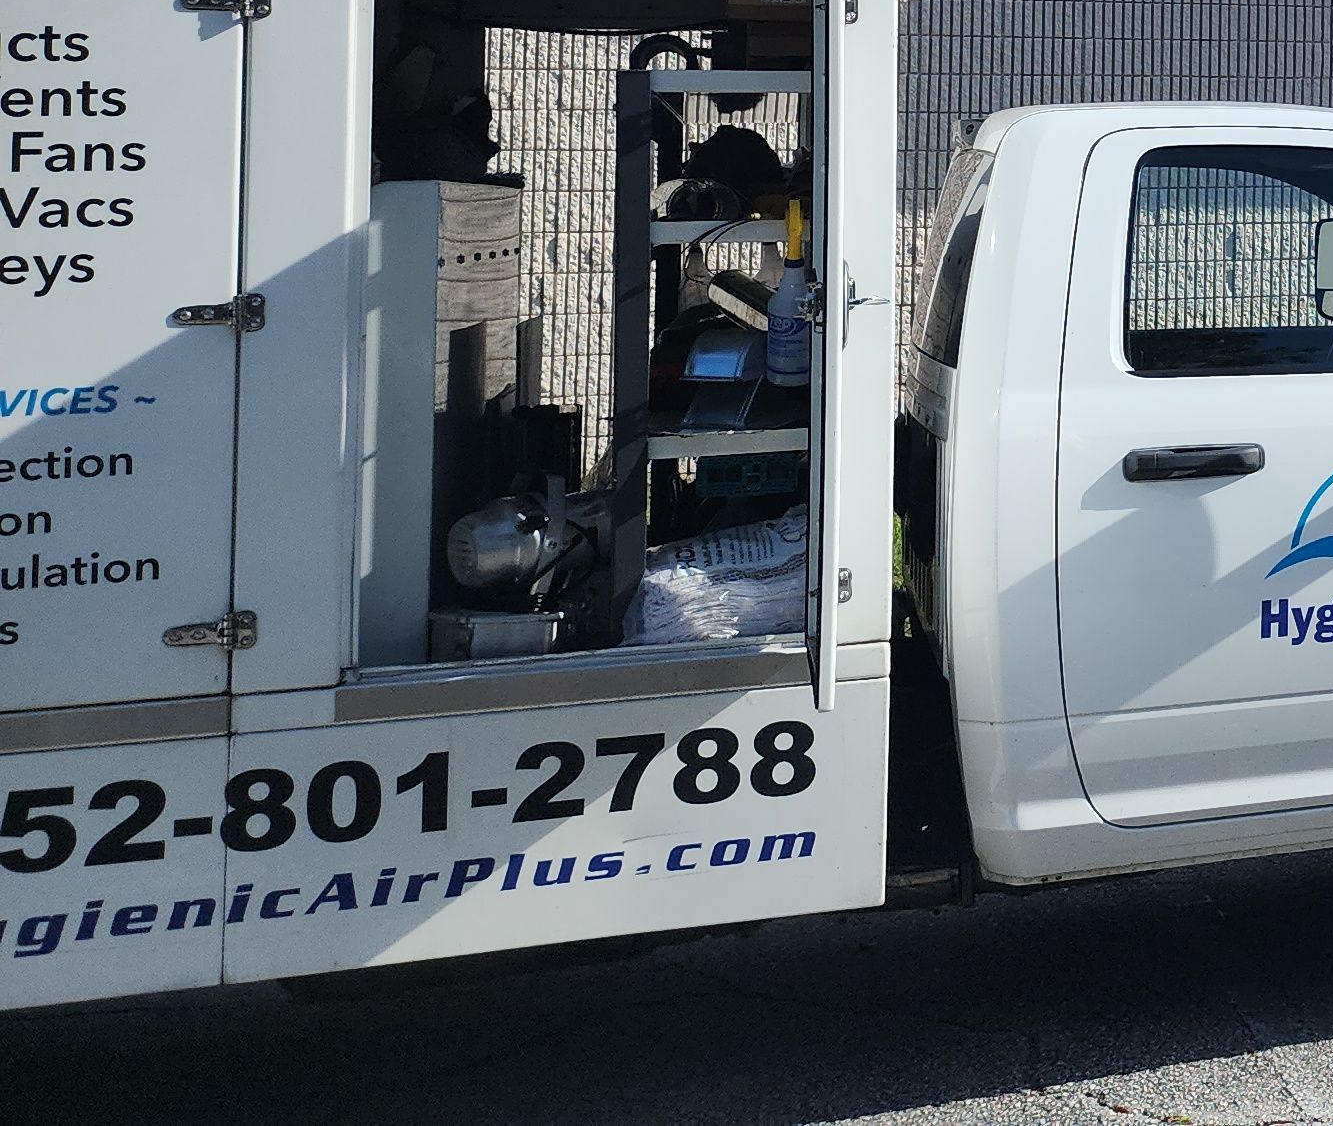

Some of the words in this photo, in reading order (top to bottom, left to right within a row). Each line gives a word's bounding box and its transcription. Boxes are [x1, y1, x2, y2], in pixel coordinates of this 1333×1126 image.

[0, 25, 91, 63] cts
[0, 80, 128, 118] ents
[11, 131, 147, 173] Fans
[0, 186, 135, 229] Vacs
[0, 253, 95, 298] eys
[0, 384, 120, 417] VICES
[0, 446, 133, 483] ection
[0, 511, 52, 536] on
[1, 552, 160, 591] ulation
[0, 720, 817, 874] 52-801-2788
[0, 830, 817, 959] gienicAirPlus.com
